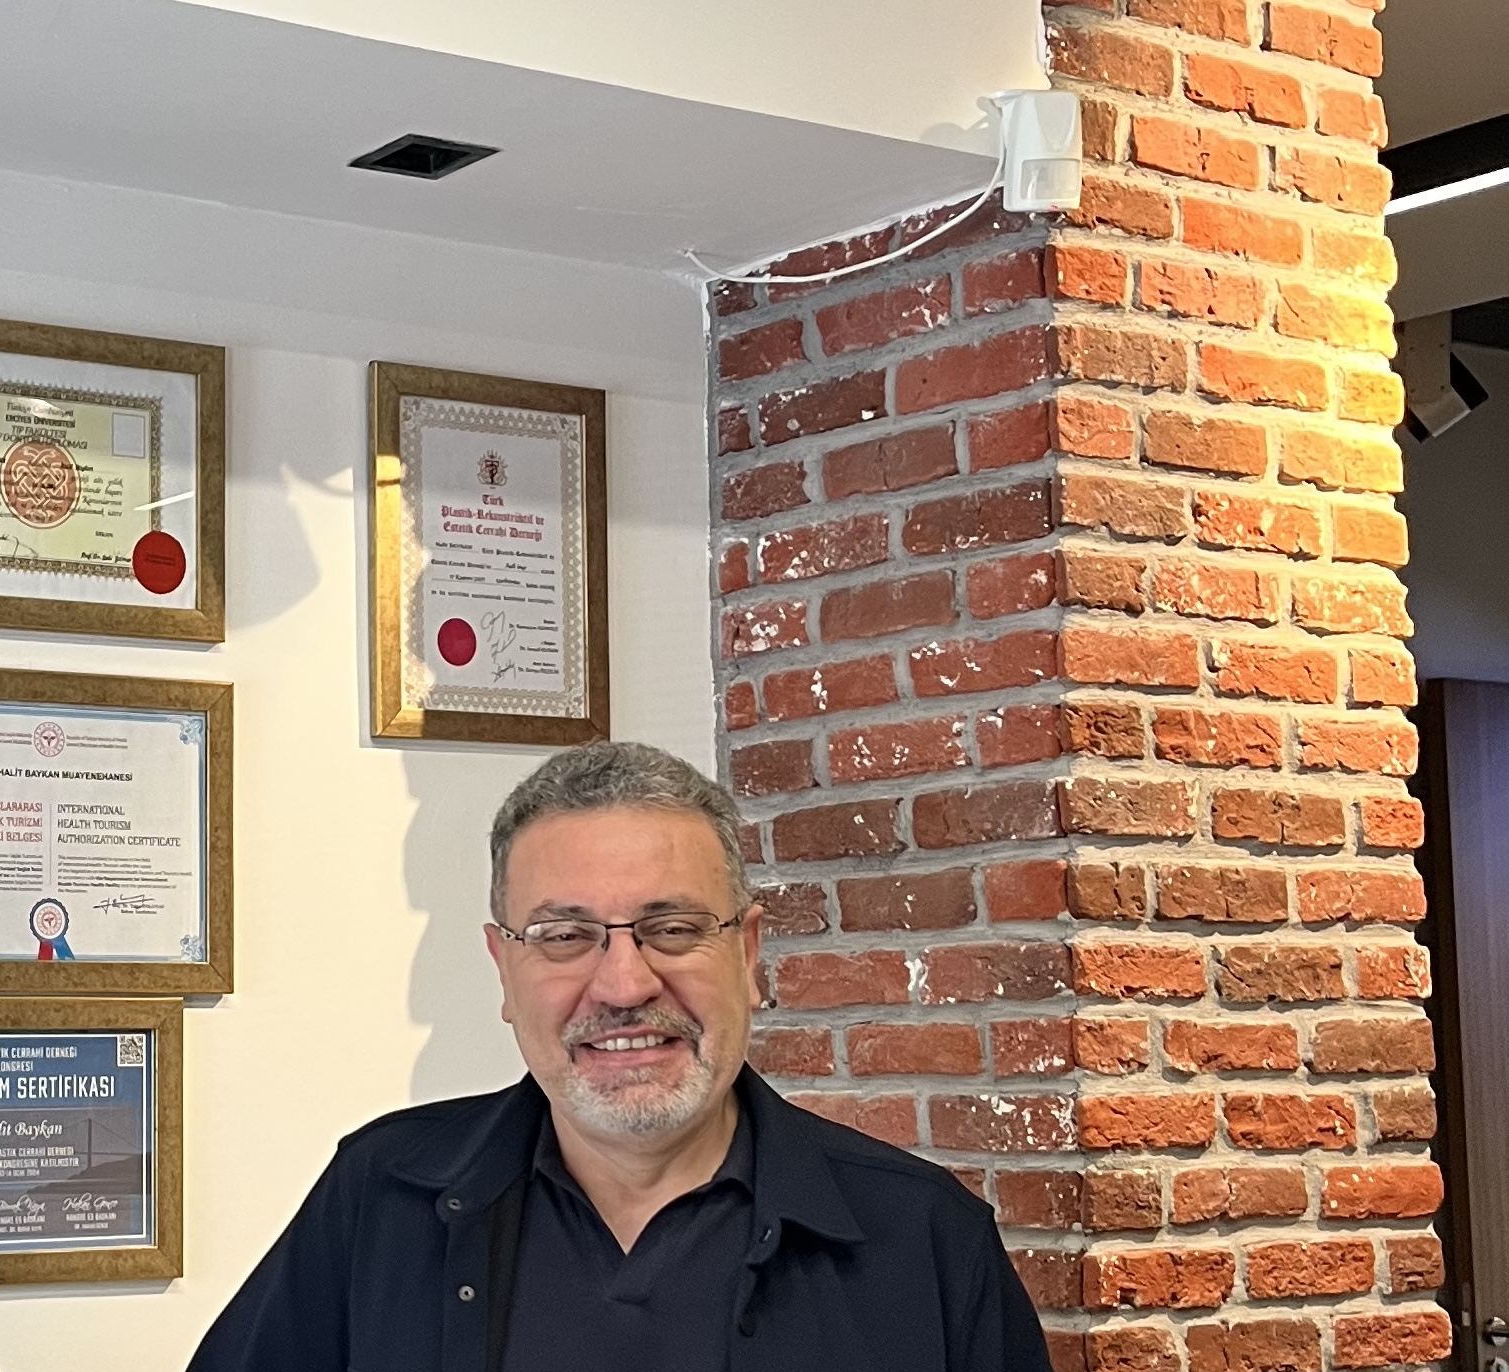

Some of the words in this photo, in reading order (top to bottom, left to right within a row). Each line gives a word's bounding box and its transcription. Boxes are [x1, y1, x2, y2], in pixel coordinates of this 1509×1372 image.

[24, 769, 60, 779] BAYKAN
[61, 771, 133, 782] MUAYENEHANESİ
[57, 803, 125, 816] INTERNATIONAL
[57, 818, 91, 830] HEALTH
[92, 819, 131, 831] TOURISM
[57, 833, 126, 846] AUTHORIZATION
[127, 834, 182, 847] CERTIFICATE
[17, 1073, 116, 1099] SERTİFİKASI
[14, 1119, 63, 1141] Baykan
